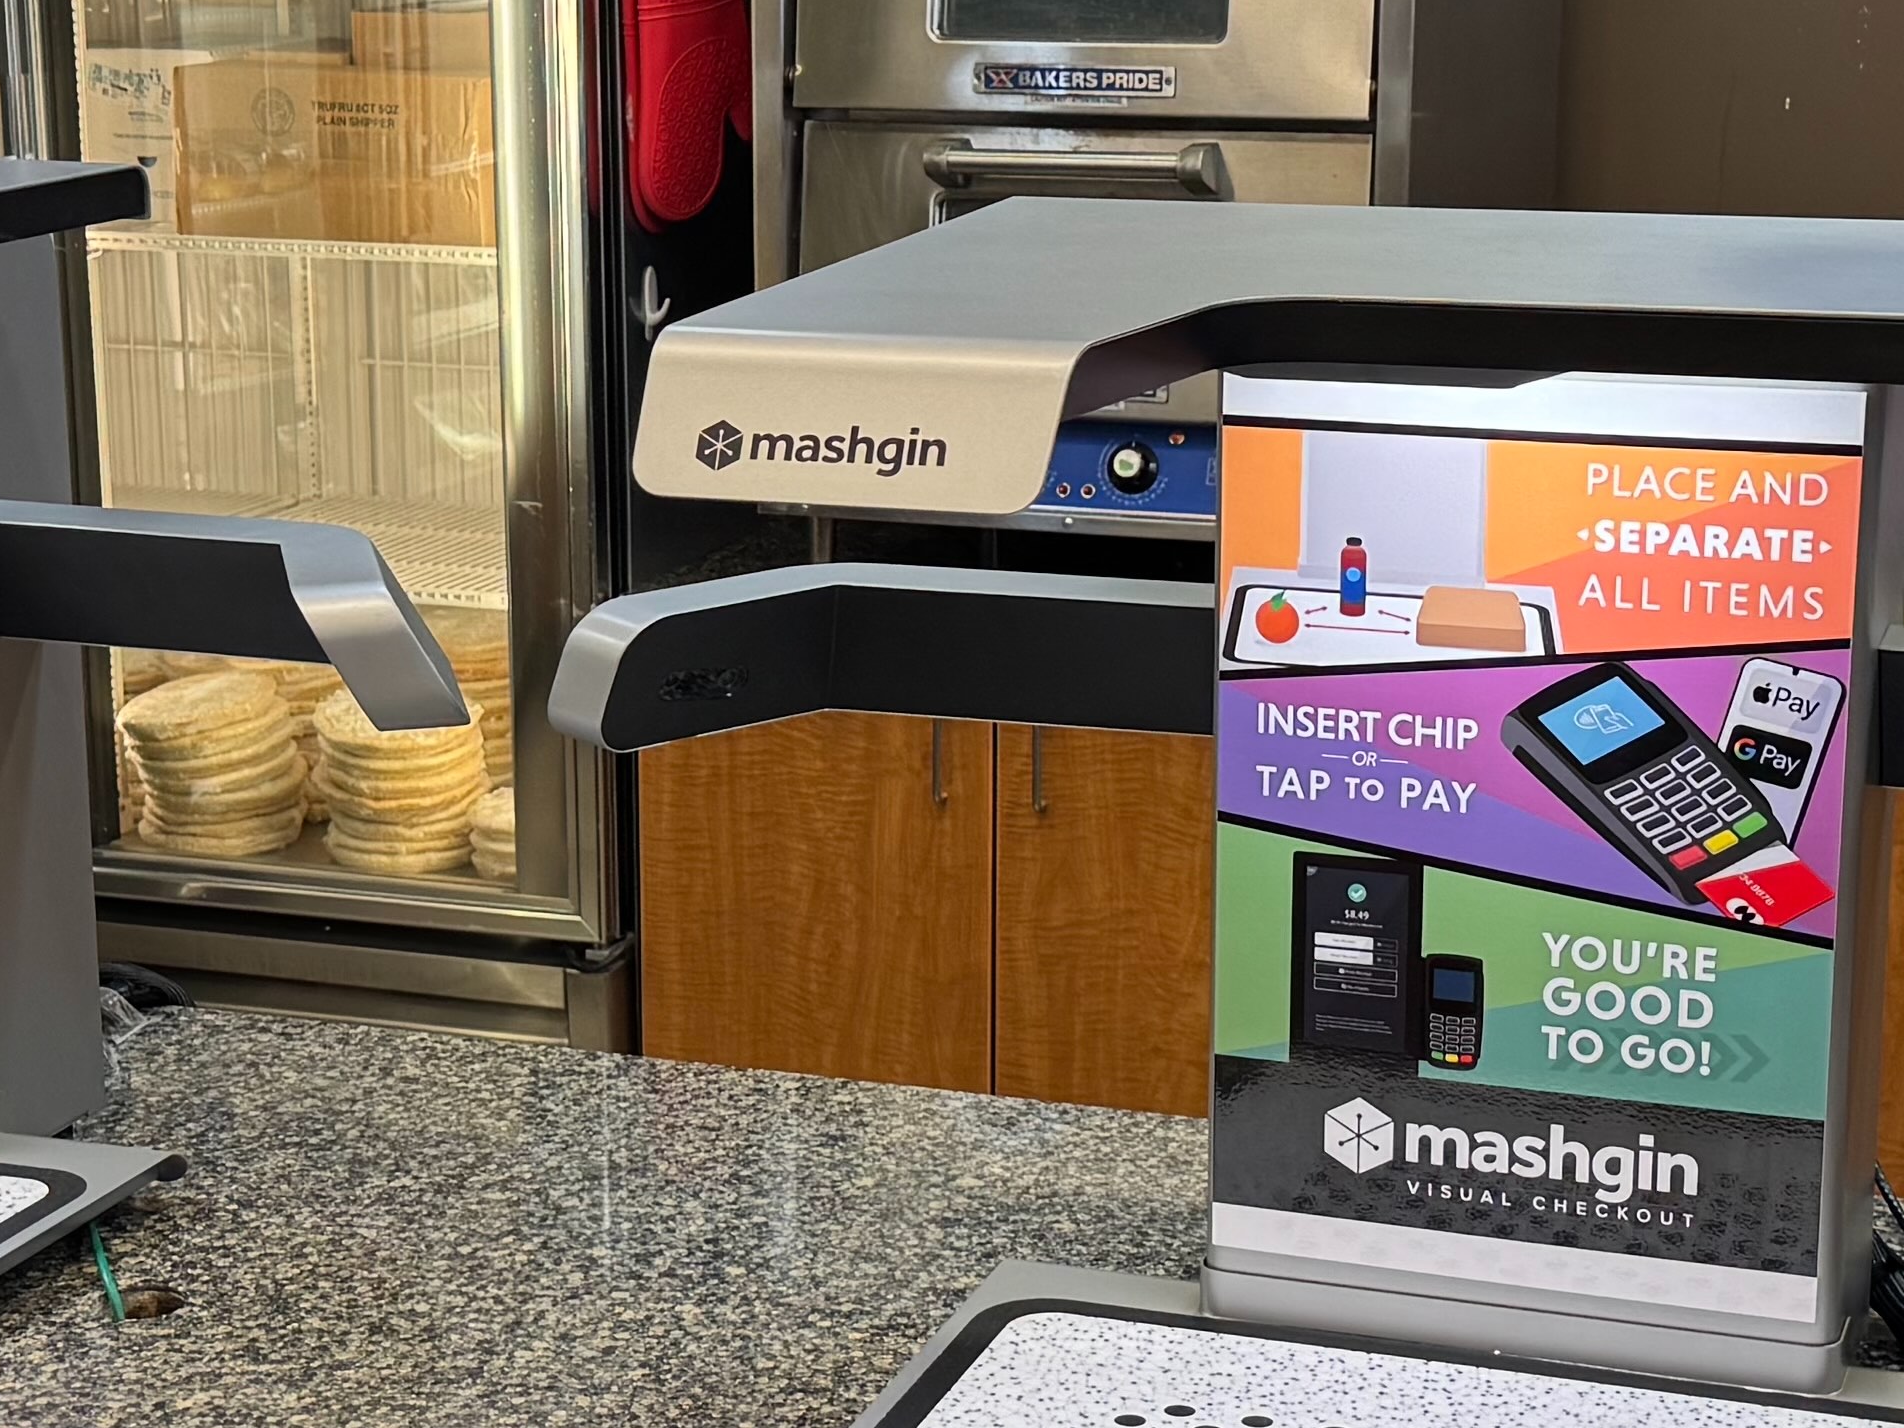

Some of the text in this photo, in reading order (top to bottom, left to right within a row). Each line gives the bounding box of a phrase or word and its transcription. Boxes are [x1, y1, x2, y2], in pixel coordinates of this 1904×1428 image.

[1019, 71, 1160, 89] BAKERS PRIDE
[751, 429, 946, 477] mashgin
[1586, 463, 1829, 506] PLACE AND
[1593, 520, 1814, 565] SEPARATE
[1578, 576, 1825, 620] ALL ITEMS
[1256, 701, 1479, 749] INSERT CHIP
[1773, 685, 1821, 722] Pay
[1352, 749, 1378, 768] OR
[1758, 744, 1801, 778] Pay
[1254, 766, 1331, 802] TAP
[1399, 777, 1478, 815] PAY
[1543, 931, 1719, 984] YOU'RE
[1541, 977, 1715, 1029] GOOD
[1541, 1025, 1714, 1078] TO GO!
[1405, 1116, 1700, 1204] mashgin
[1407, 1180, 1696, 1229] VISUAL CHECKOUT
